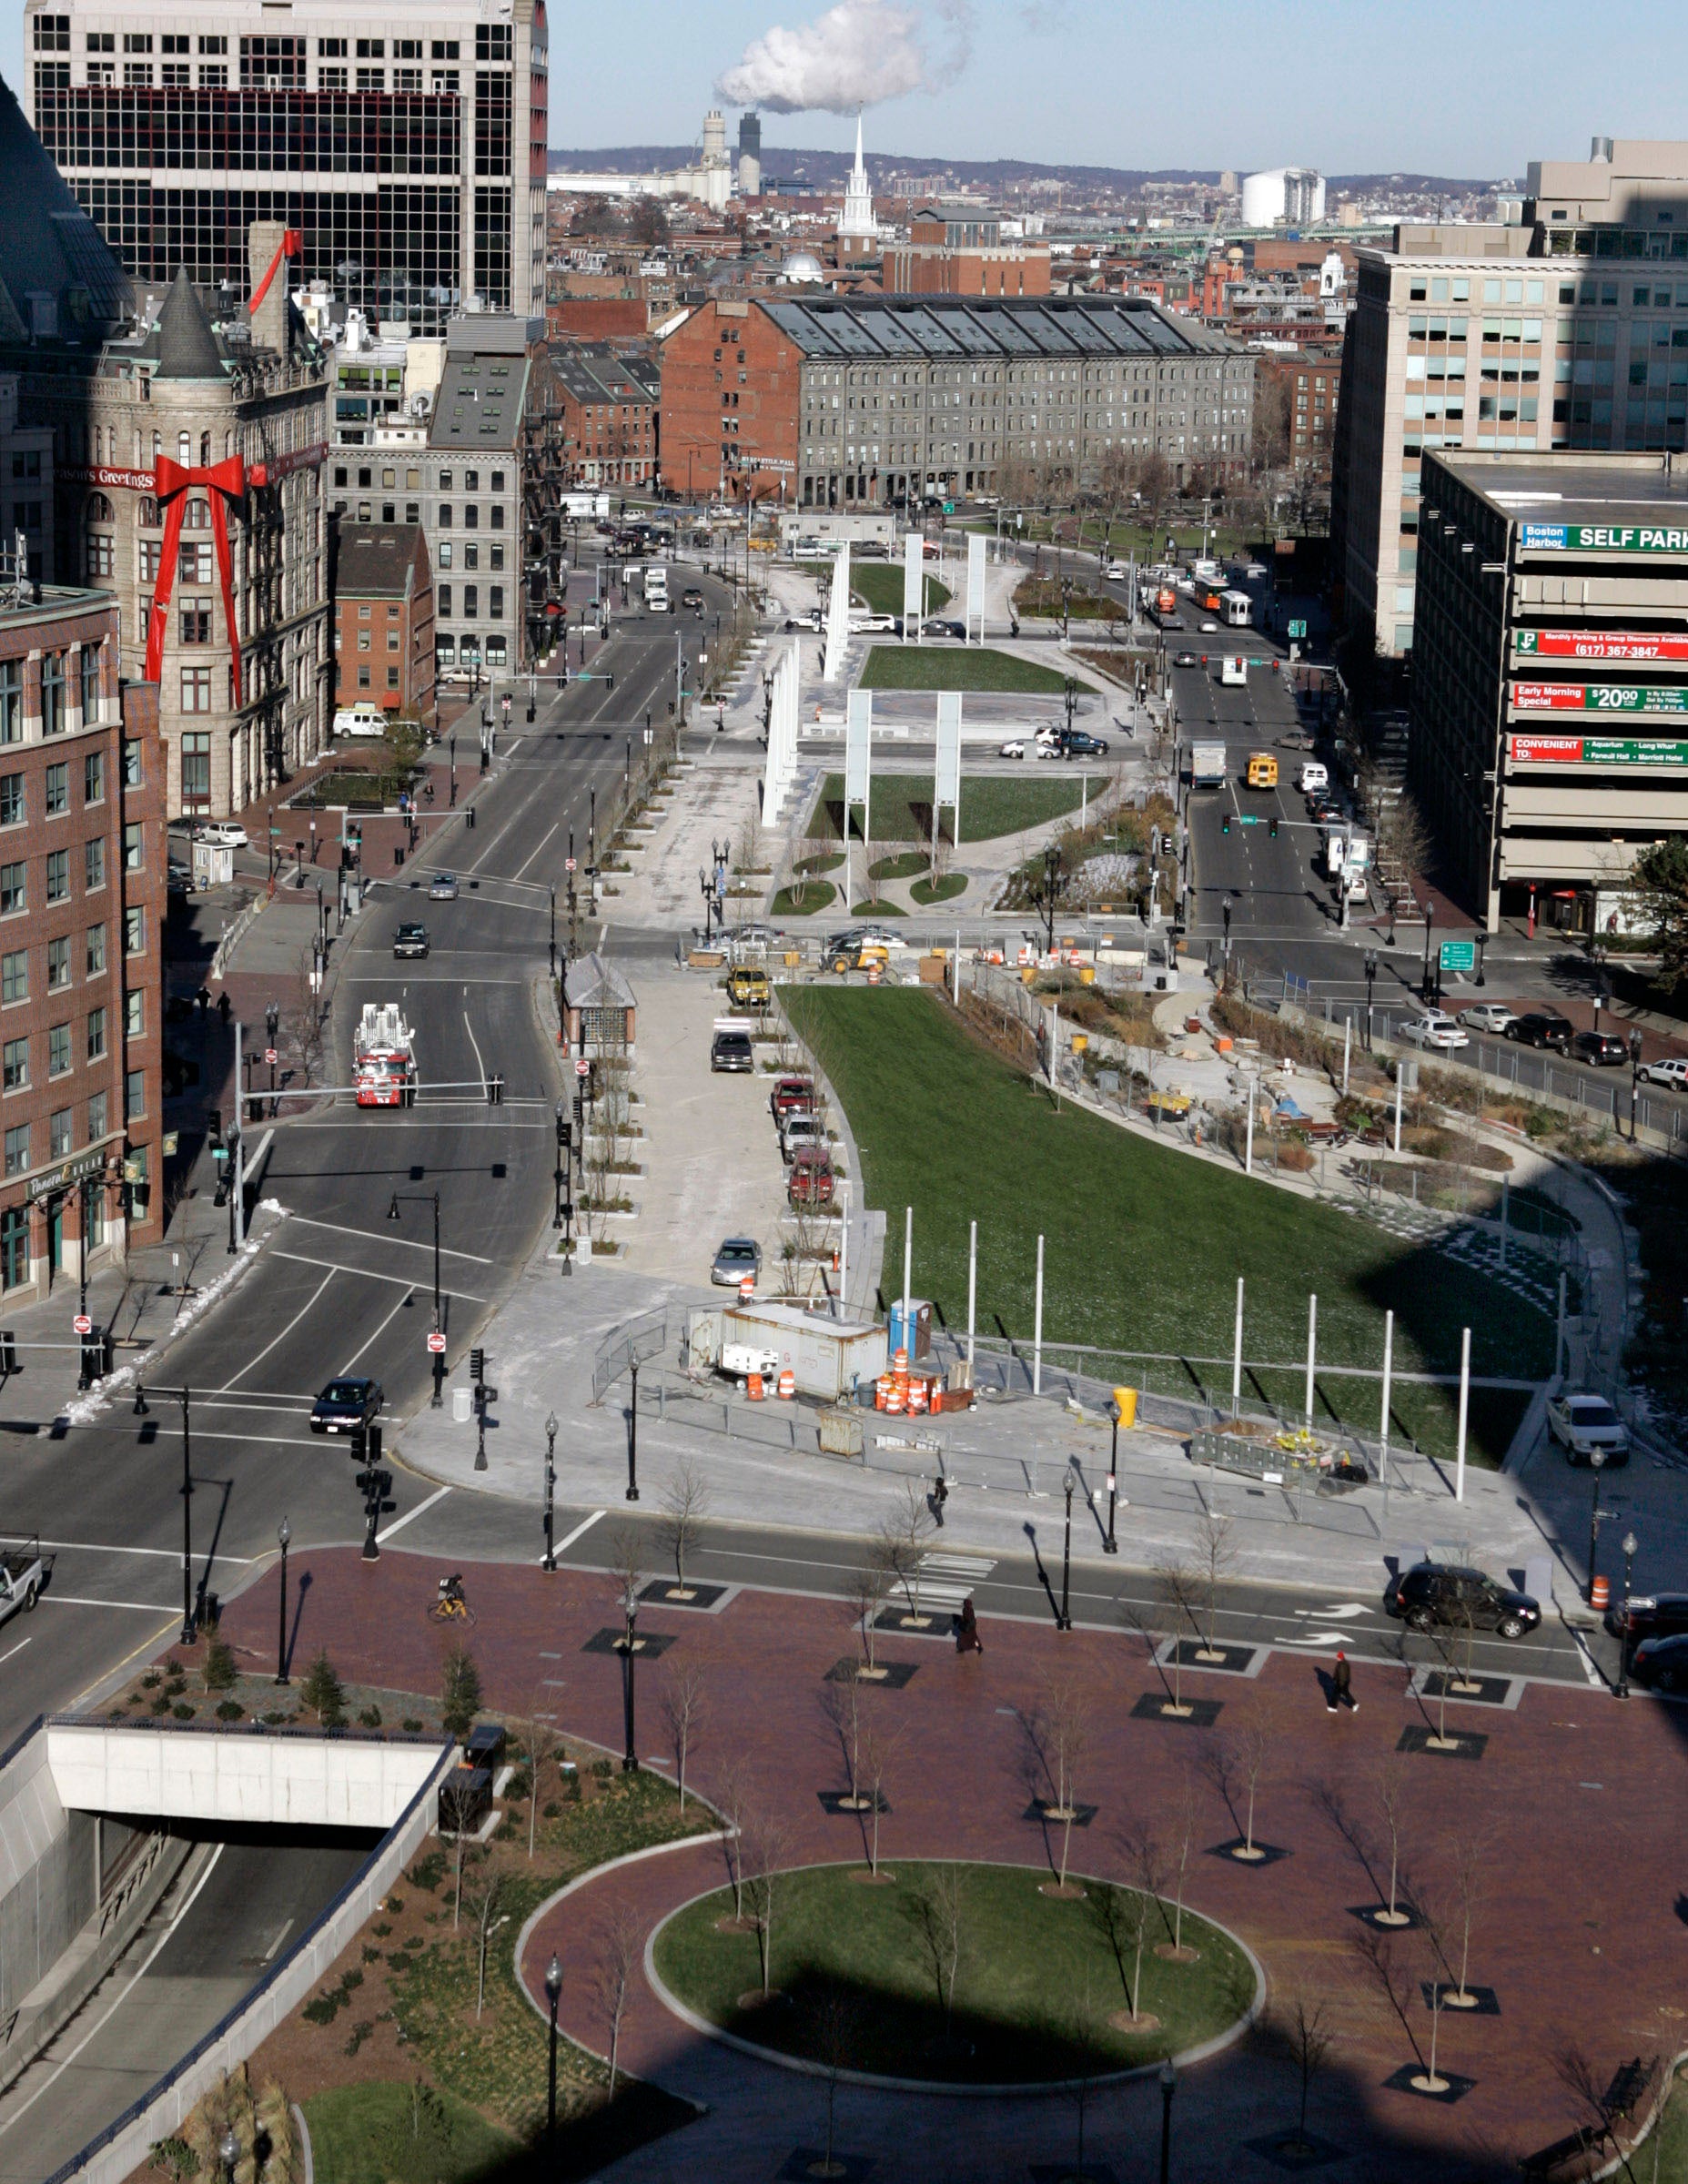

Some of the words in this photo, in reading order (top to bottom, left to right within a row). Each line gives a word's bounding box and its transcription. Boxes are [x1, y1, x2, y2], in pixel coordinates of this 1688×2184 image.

[1527, 526, 1563, 537] Boston
[1580, 528, 1634, 546] SELF
[1526, 537, 1562, 547] Harbor
[1545, 632, 1572, 642] Monthly
[1572, 633, 1597, 642] Parking
[1605, 634, 1625, 643] Group
[1627, 635, 1660, 643] Discounts
[1575, 643, 1604, 656] (617)
[1607, 644, 1658, 656] 367-3847
[1518, 686, 1541, 697] Early
[1543, 687, 1582, 698] Morning
[1518, 696, 1551, 707] Special
[1516, 738, 1578, 749] CONVENIENT
[1592, 741, 1624, 750] Aquarium
[1516, 749, 1532, 758] TO:
[1591, 752, 1615, 760] Faneuil
[30, 1173, 61, 1195] Panera
